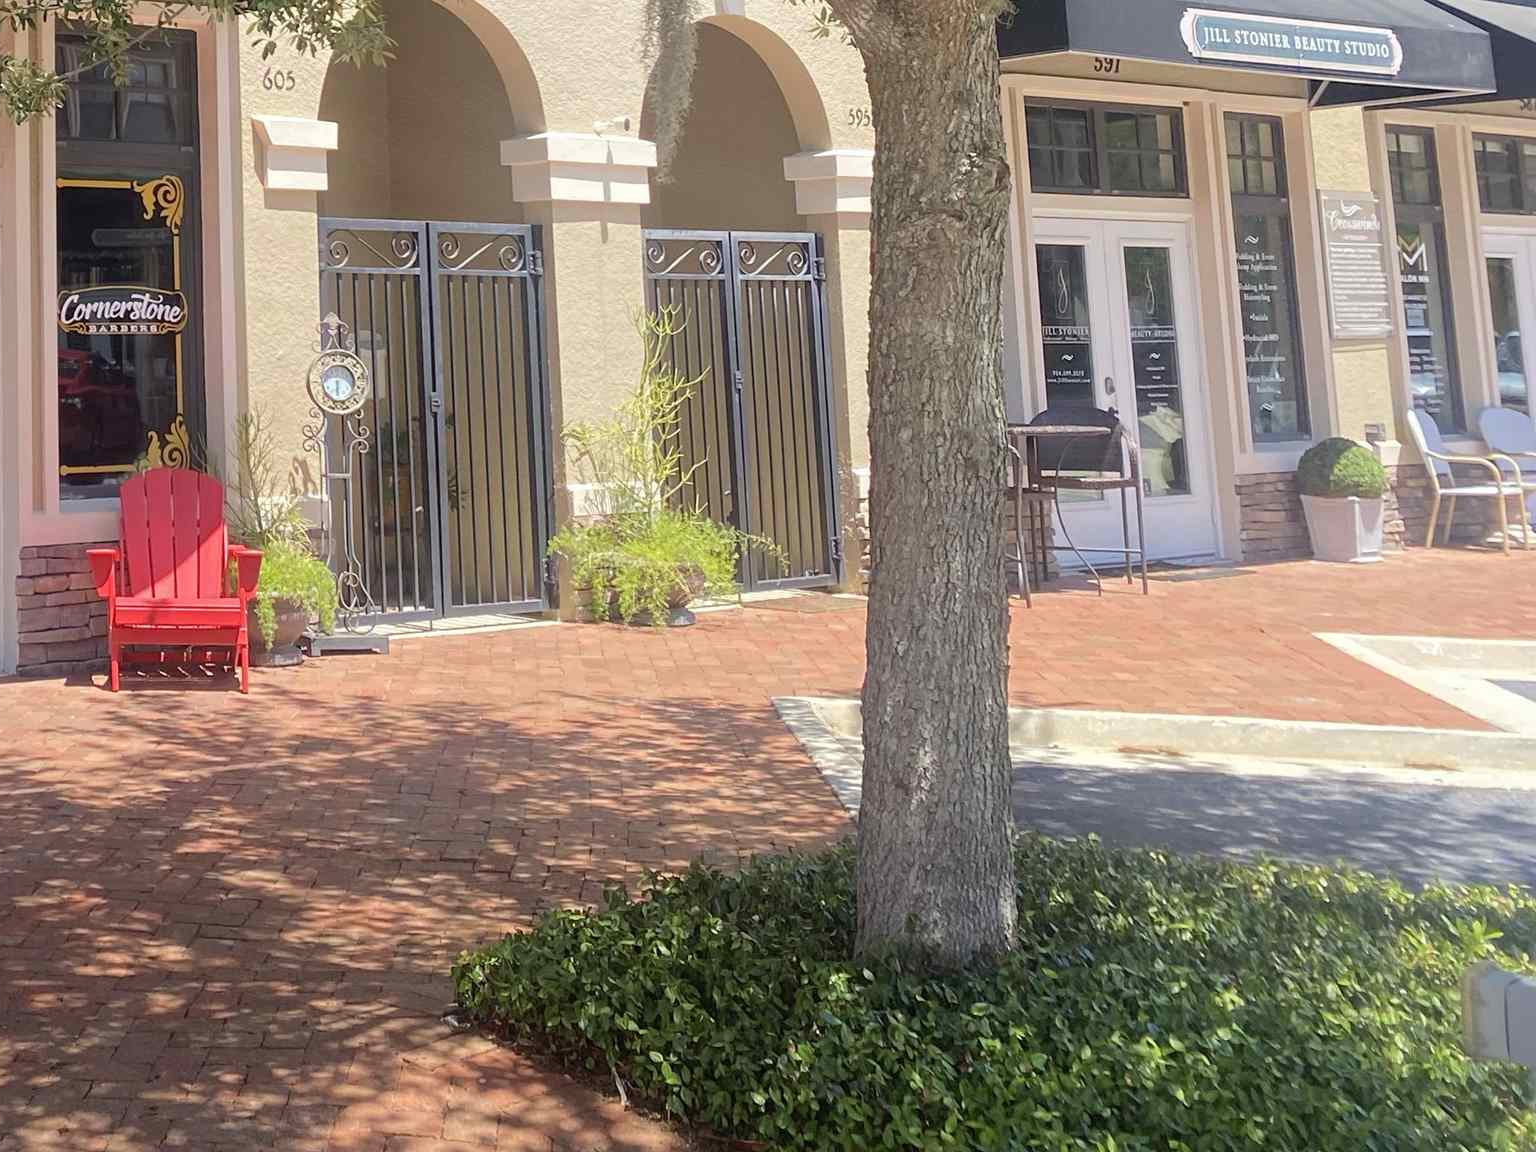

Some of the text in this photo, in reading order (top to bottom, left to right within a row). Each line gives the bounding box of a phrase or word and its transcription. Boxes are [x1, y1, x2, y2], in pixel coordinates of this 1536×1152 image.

[1204, 27, 1390, 58] JILL STONIER BEAUTY STUDIO
[1094, 56, 1120, 74] 591
[262, 67, 295, 91] 605
[848, 108, 870, 128] 595
[60, 293, 184, 324] Cornerstone
[88, 324, 158, 333] BARBERS
